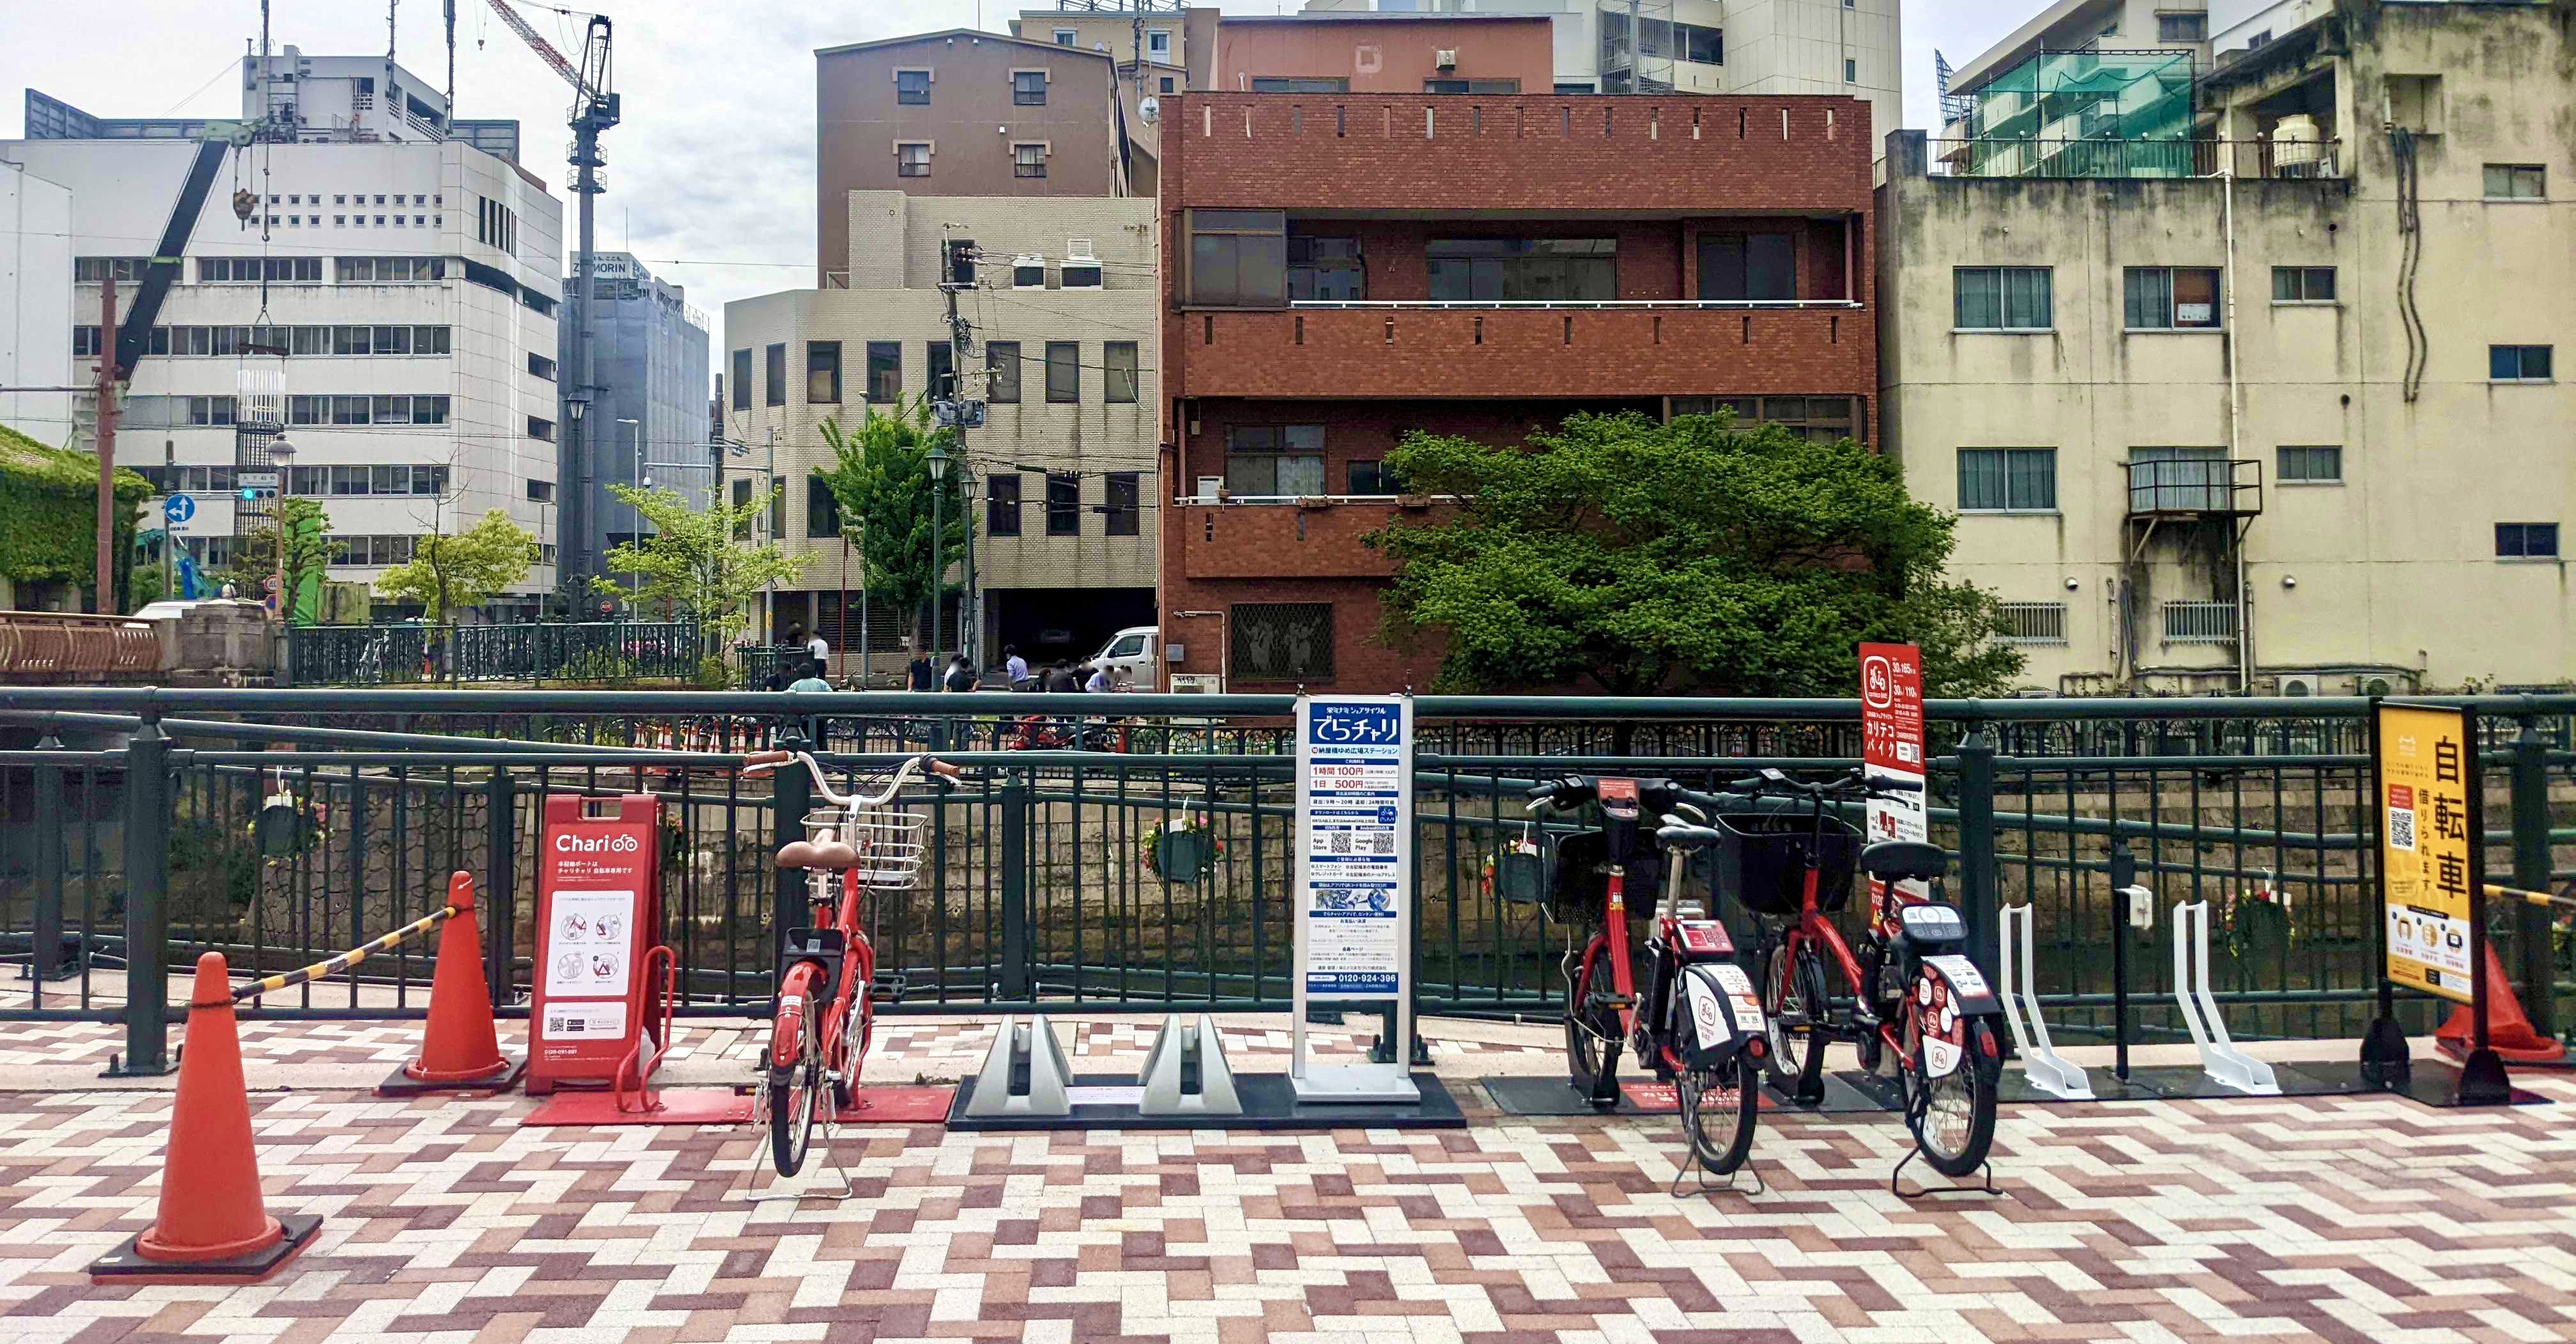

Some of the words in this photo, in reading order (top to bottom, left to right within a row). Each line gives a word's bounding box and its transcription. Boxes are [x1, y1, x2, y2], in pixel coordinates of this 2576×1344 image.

[1313, 715, 1397, 742] でらチャリ
[1866, 719, 1894, 738] カリテコ
[1867, 738, 1894, 758] バイク
[1337, 767, 1363, 775] 100円
[1314, 780, 1326, 788] 1日
[1335, 780, 1363, 788] 500円
[2434, 735, 2467, 899] 自転車
[556, 834, 610, 851] Chari
[2418, 788, 2430, 891] 借りられます
